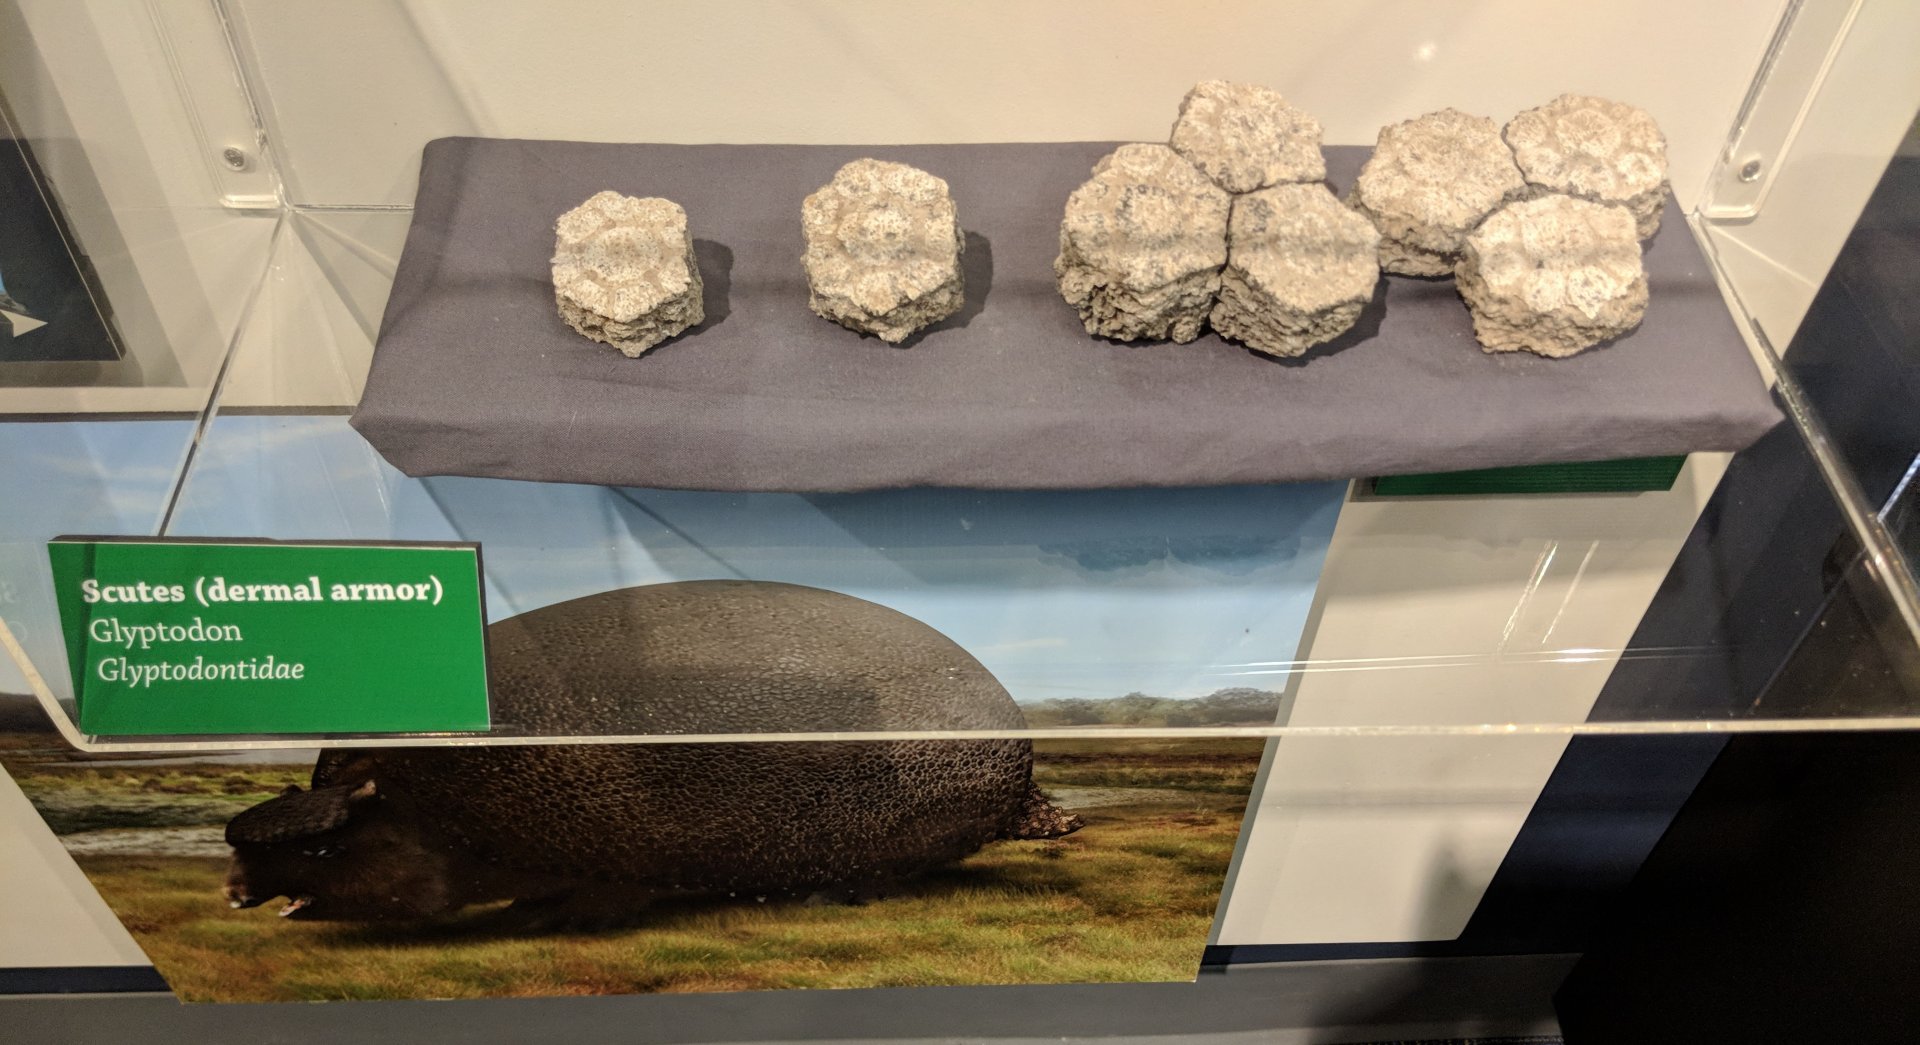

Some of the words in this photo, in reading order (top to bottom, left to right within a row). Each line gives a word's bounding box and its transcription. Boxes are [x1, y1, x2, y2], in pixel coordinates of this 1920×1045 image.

[82, 579, 185, 603] Scutes
[195, 576, 323, 607] (dermal
[331, 575, 443, 605] armor)
[90, 617, 243, 649] Glyptodon
[98, 656, 305, 688] Glyptodontidae
